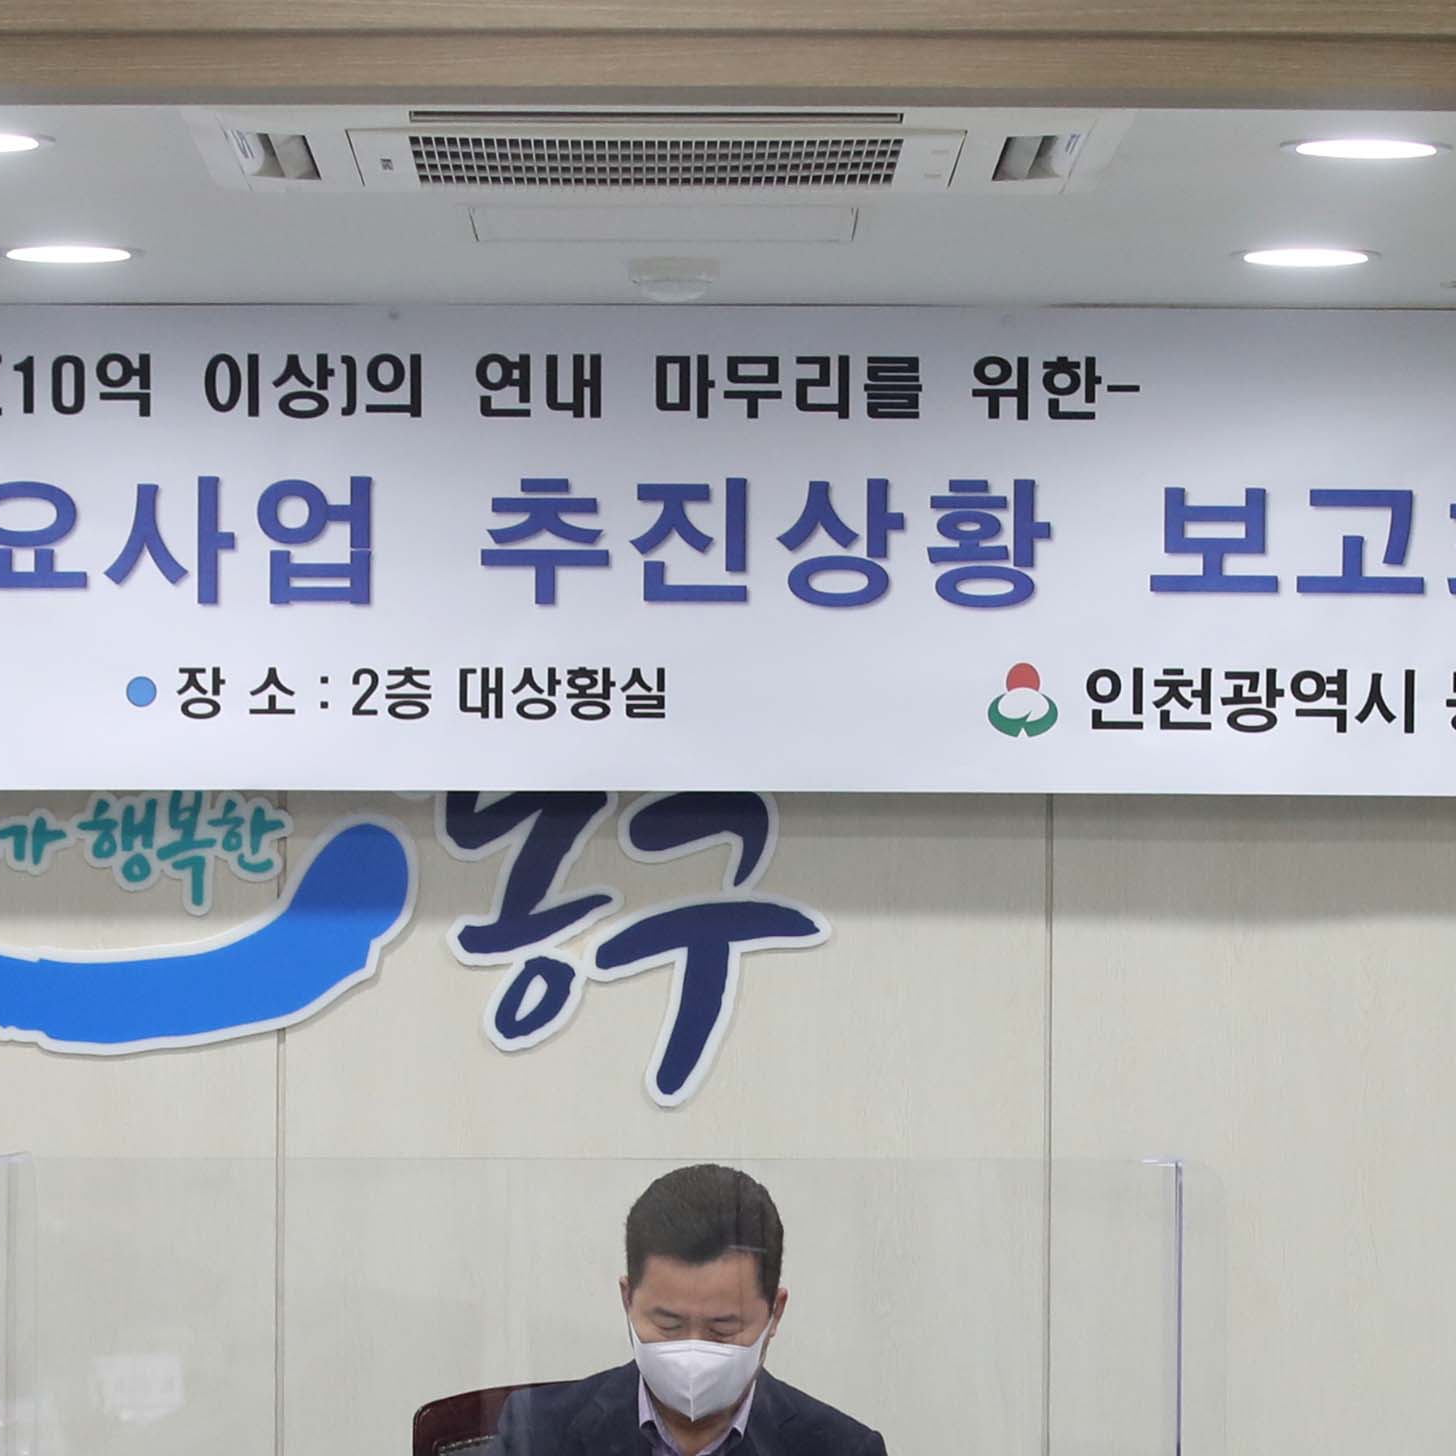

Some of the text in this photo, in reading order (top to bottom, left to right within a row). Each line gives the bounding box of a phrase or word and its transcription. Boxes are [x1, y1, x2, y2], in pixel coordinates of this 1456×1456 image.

[205, 353, 421, 419] 이상)의
[476, 353, 602, 418] 연내
[656, 354, 922, 419] 마무리를
[972, 356, 1140, 420] 위한-
[481, 478, 1051, 608] 추진상황
[352, 667, 431, 719] 2층
[460, 667, 665, 720] 대상황실
[1087, 668, 1415, 733] 인천광역시
[77, 791, 286, 906] 행복한
